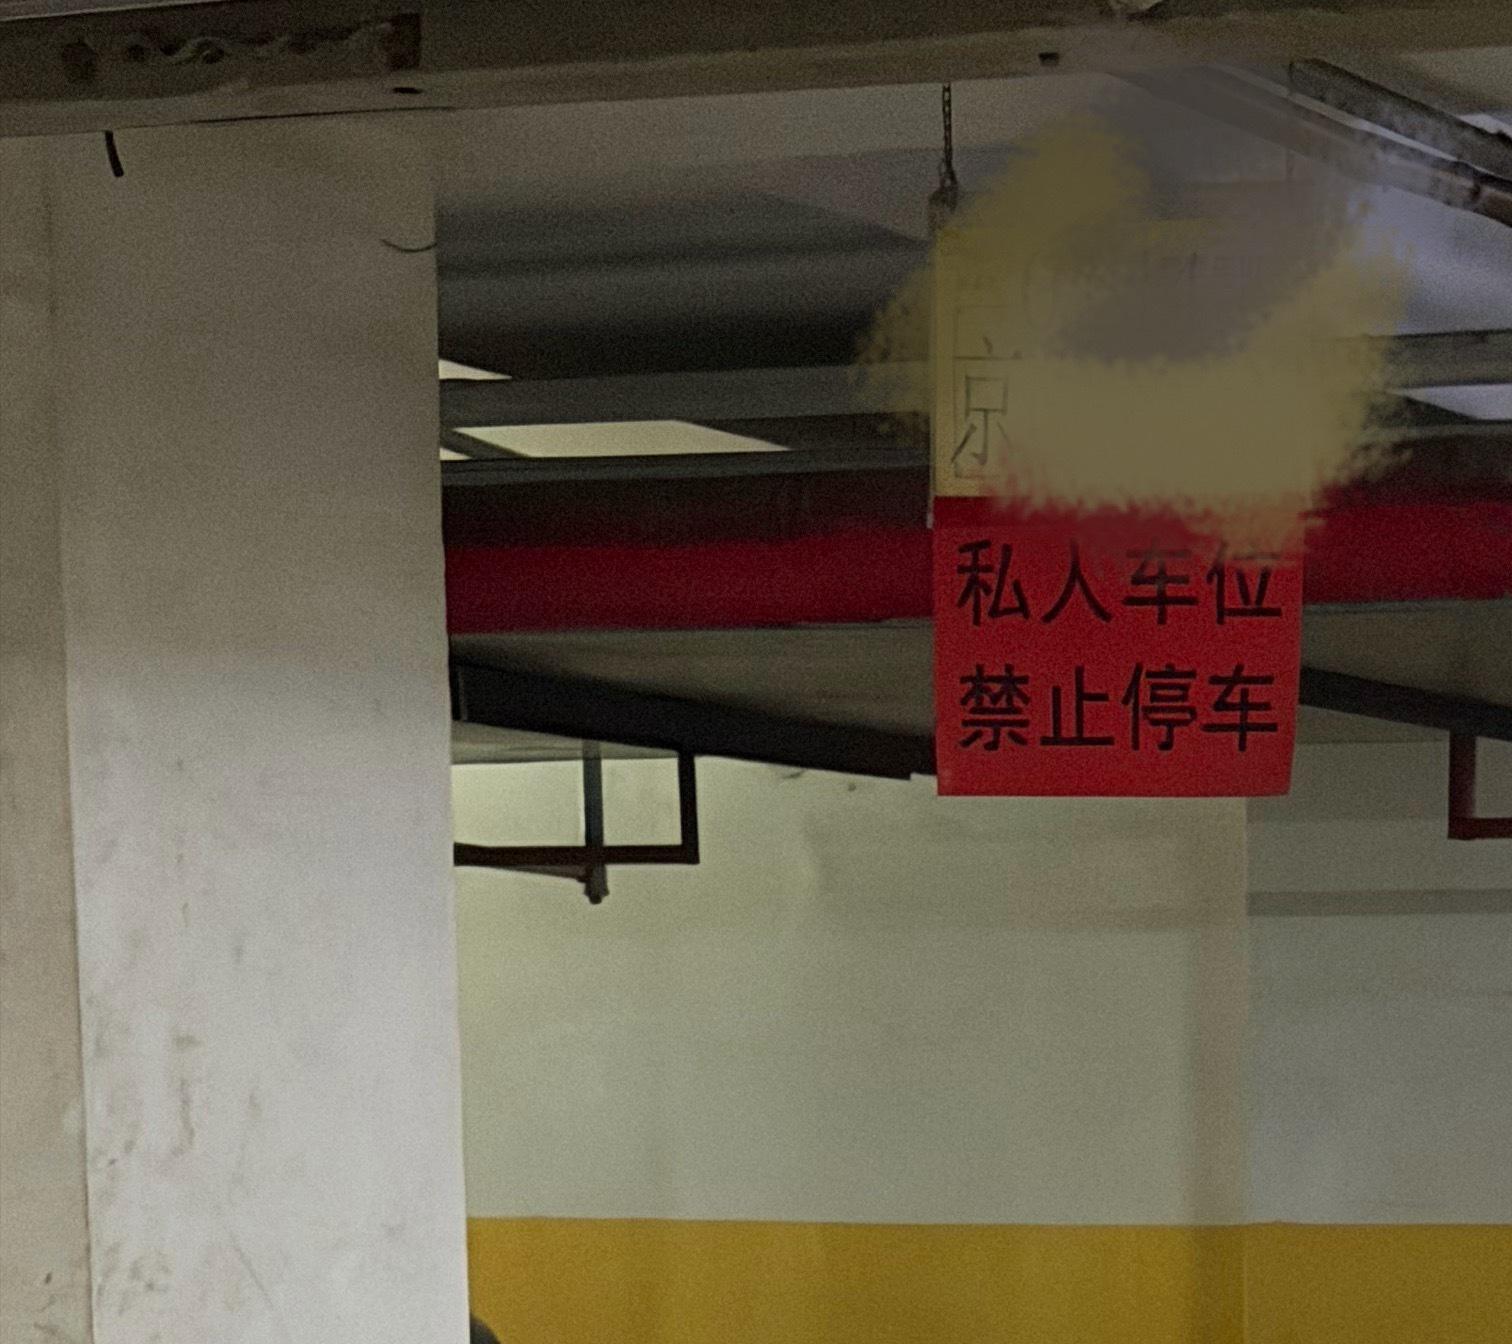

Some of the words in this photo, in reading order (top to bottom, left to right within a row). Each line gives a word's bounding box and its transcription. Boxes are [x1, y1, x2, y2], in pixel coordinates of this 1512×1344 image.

[956, 539, 1284, 627] 私人车位
[958, 661, 1280, 752] 禁止停车
